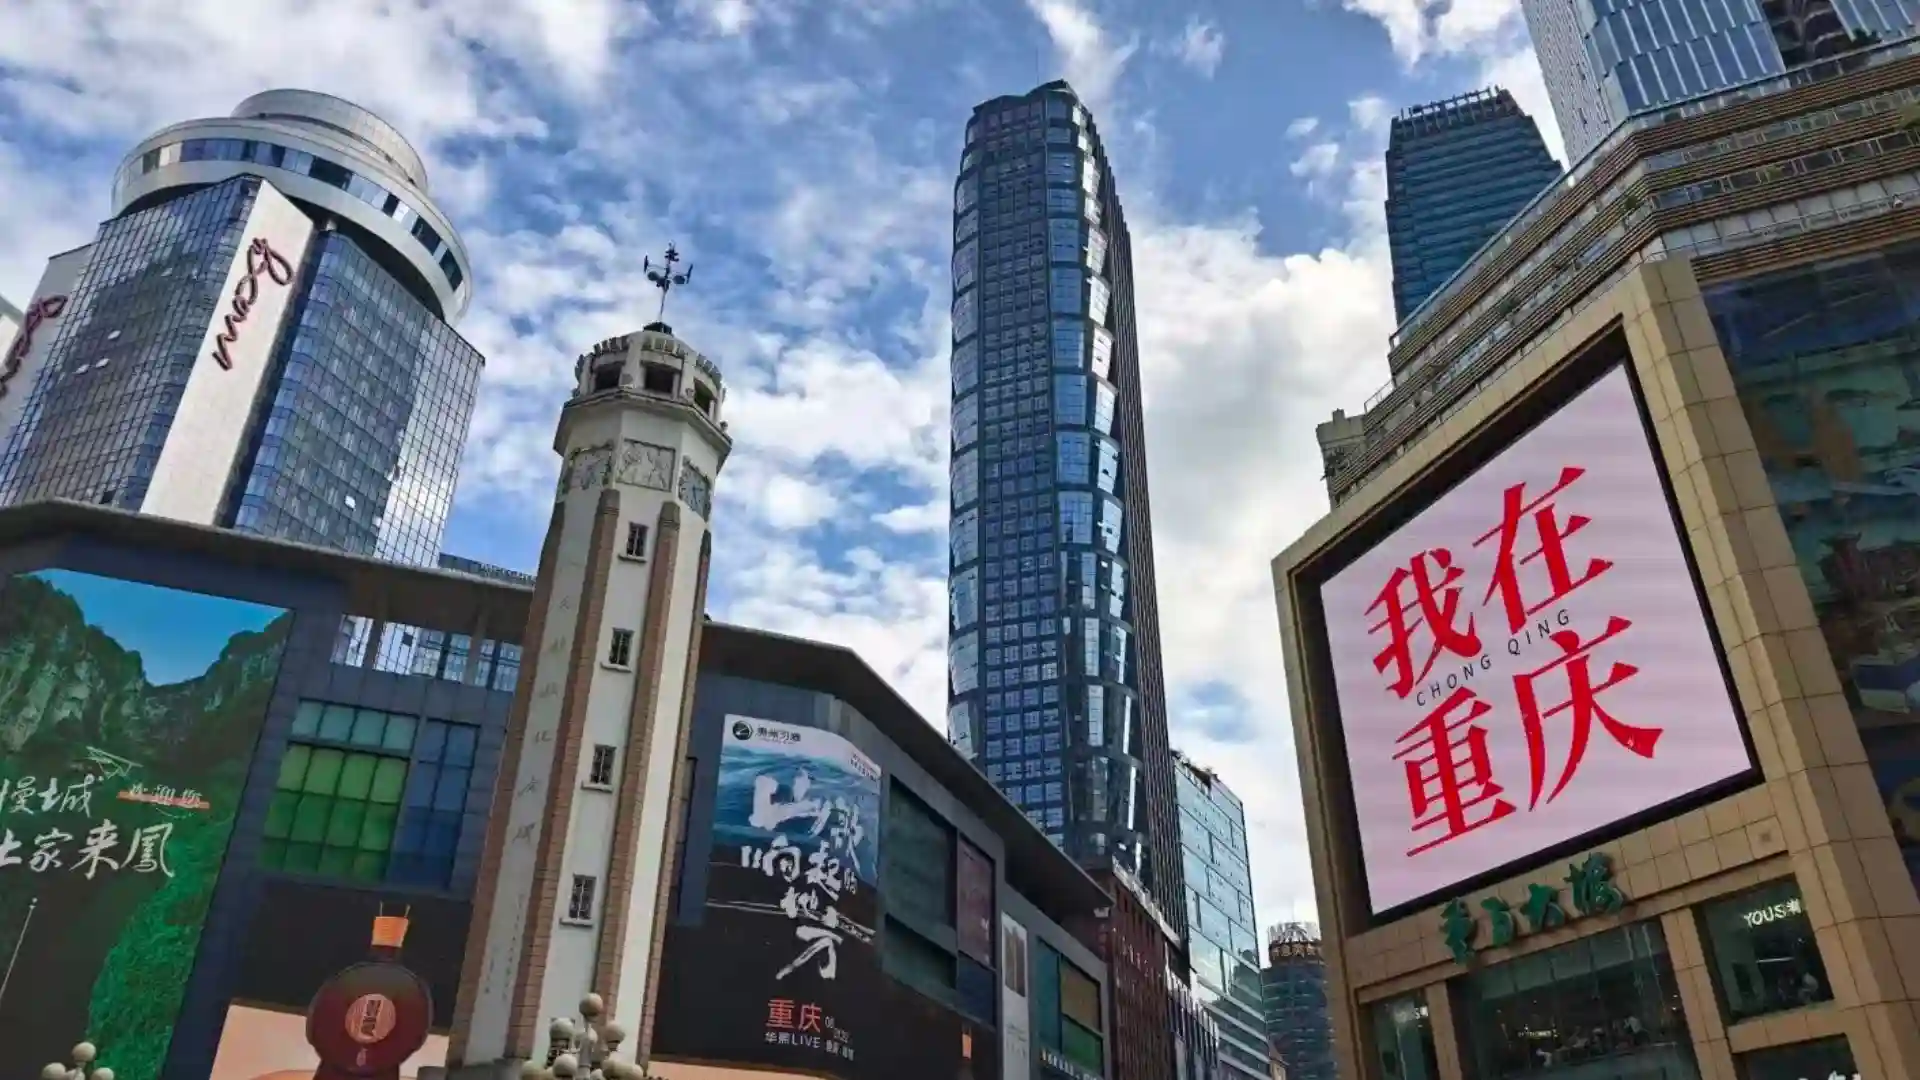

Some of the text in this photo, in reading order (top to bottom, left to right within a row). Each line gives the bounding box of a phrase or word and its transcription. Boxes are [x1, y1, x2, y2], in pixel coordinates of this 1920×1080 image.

[1365, 467, 1614, 699] 我在
[1416, 608, 1570, 707] CHONG QING
[1393, 616, 1664, 857] 重庆
[765, 999, 822, 1033] 重庆
